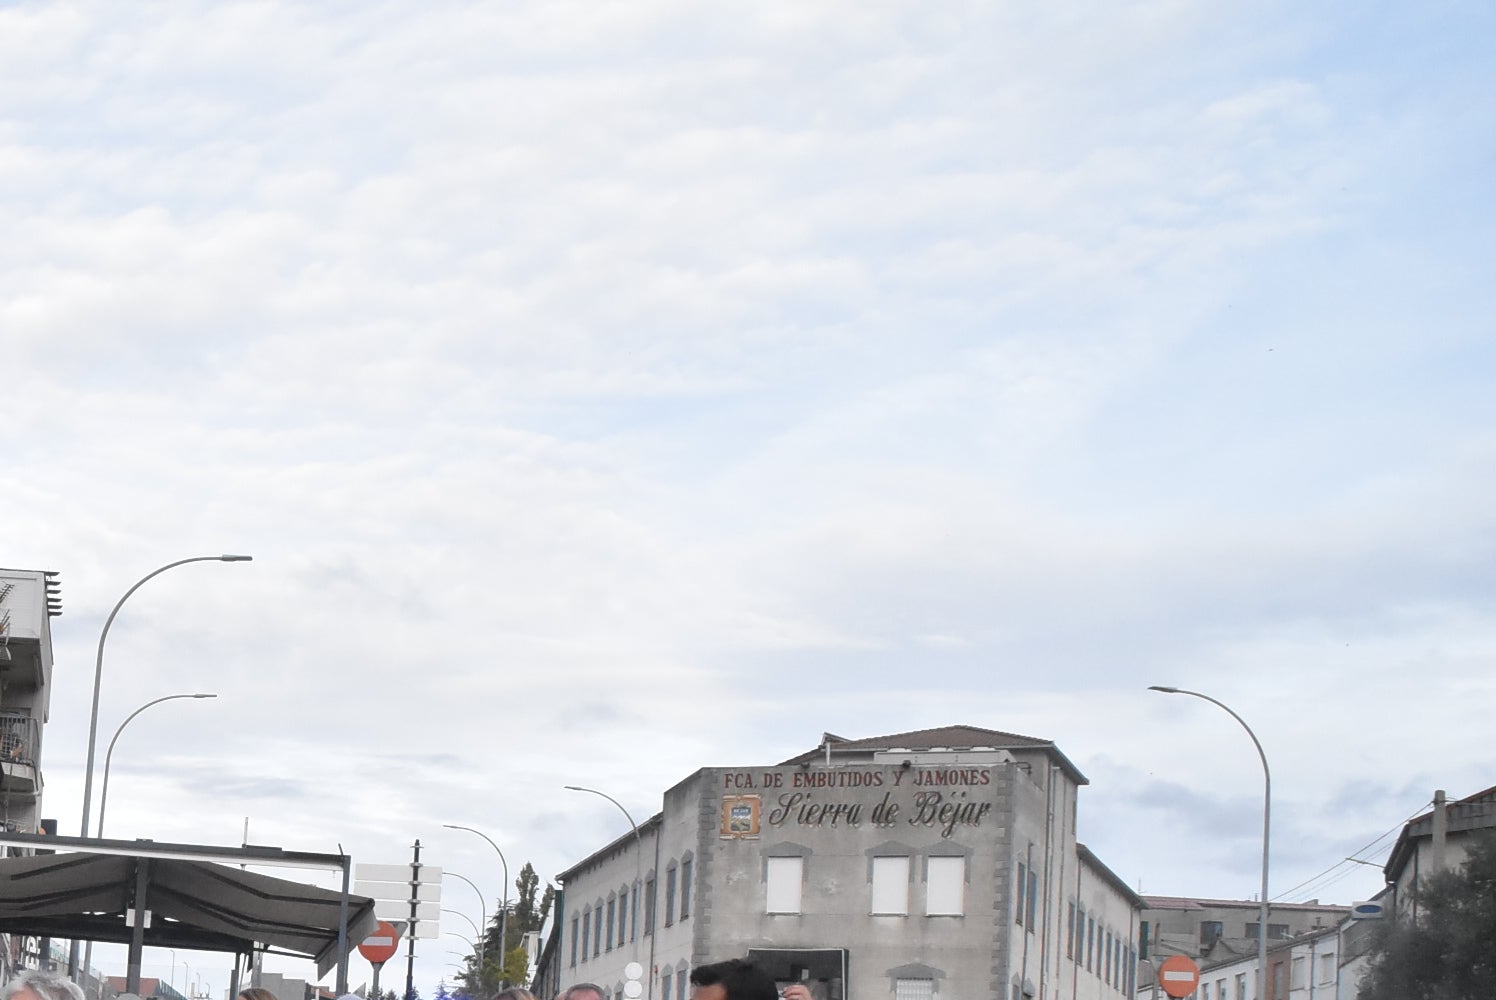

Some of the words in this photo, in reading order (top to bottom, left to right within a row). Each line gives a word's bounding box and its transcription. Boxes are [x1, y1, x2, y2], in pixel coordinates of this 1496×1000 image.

[724, 773, 757, 788] FCA.
[763, 772, 784, 788] DE
[793, 771, 883, 788] EMBUTIDOS
[893, 770, 904, 786] Y
[913, 769, 990, 786] JAMONES
[769, 792, 863, 825] Sierra
[871, 791, 900, 825] de
[908, 790, 991, 838] Béjar
